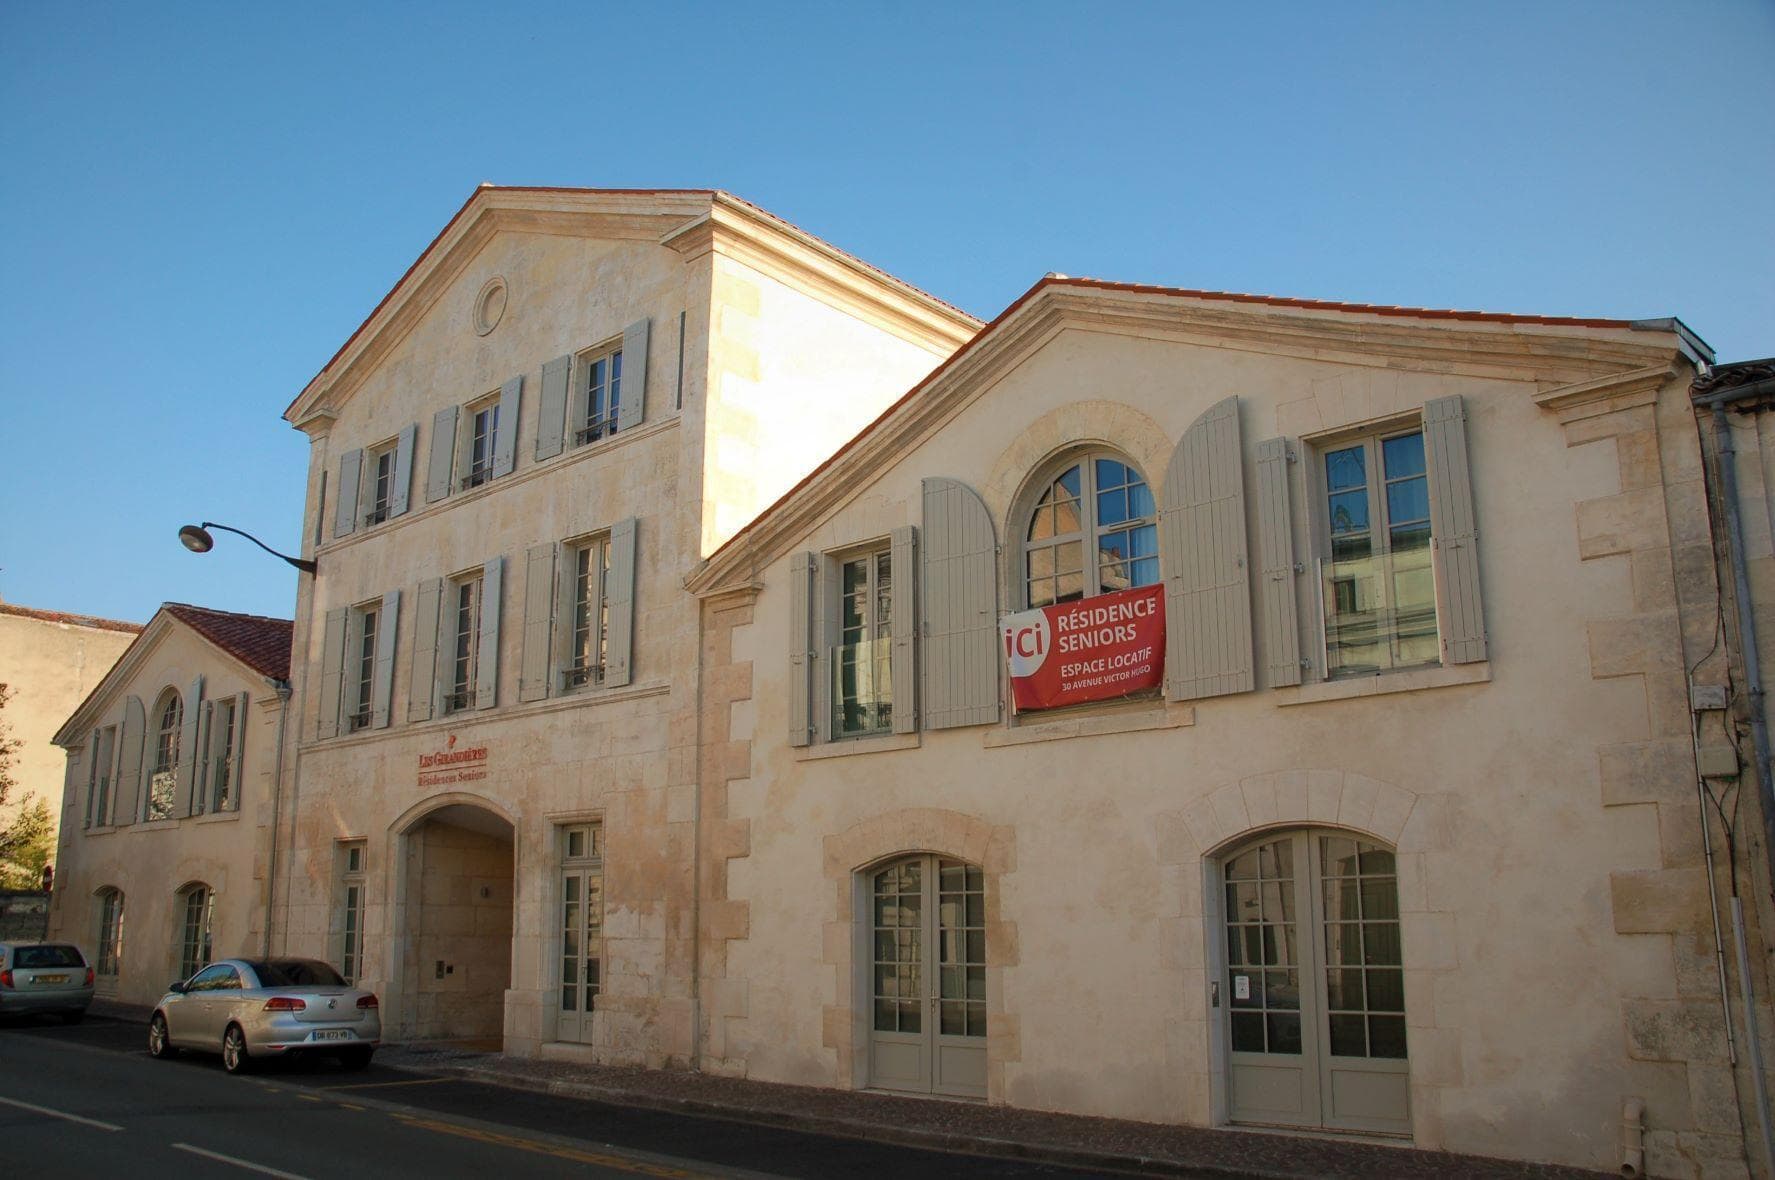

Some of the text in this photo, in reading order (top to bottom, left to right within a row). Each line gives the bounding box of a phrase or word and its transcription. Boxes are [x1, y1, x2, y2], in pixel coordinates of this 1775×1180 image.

[1058, 598, 1156, 632] RÉSIDENCE
[1059, 624, 1136, 653] SENIORS
[1061, 647, 1152, 678] ESPACE LOCATIF
[1062, 664, 1151, 692] 30 AVENUE VICTOR HUGO
